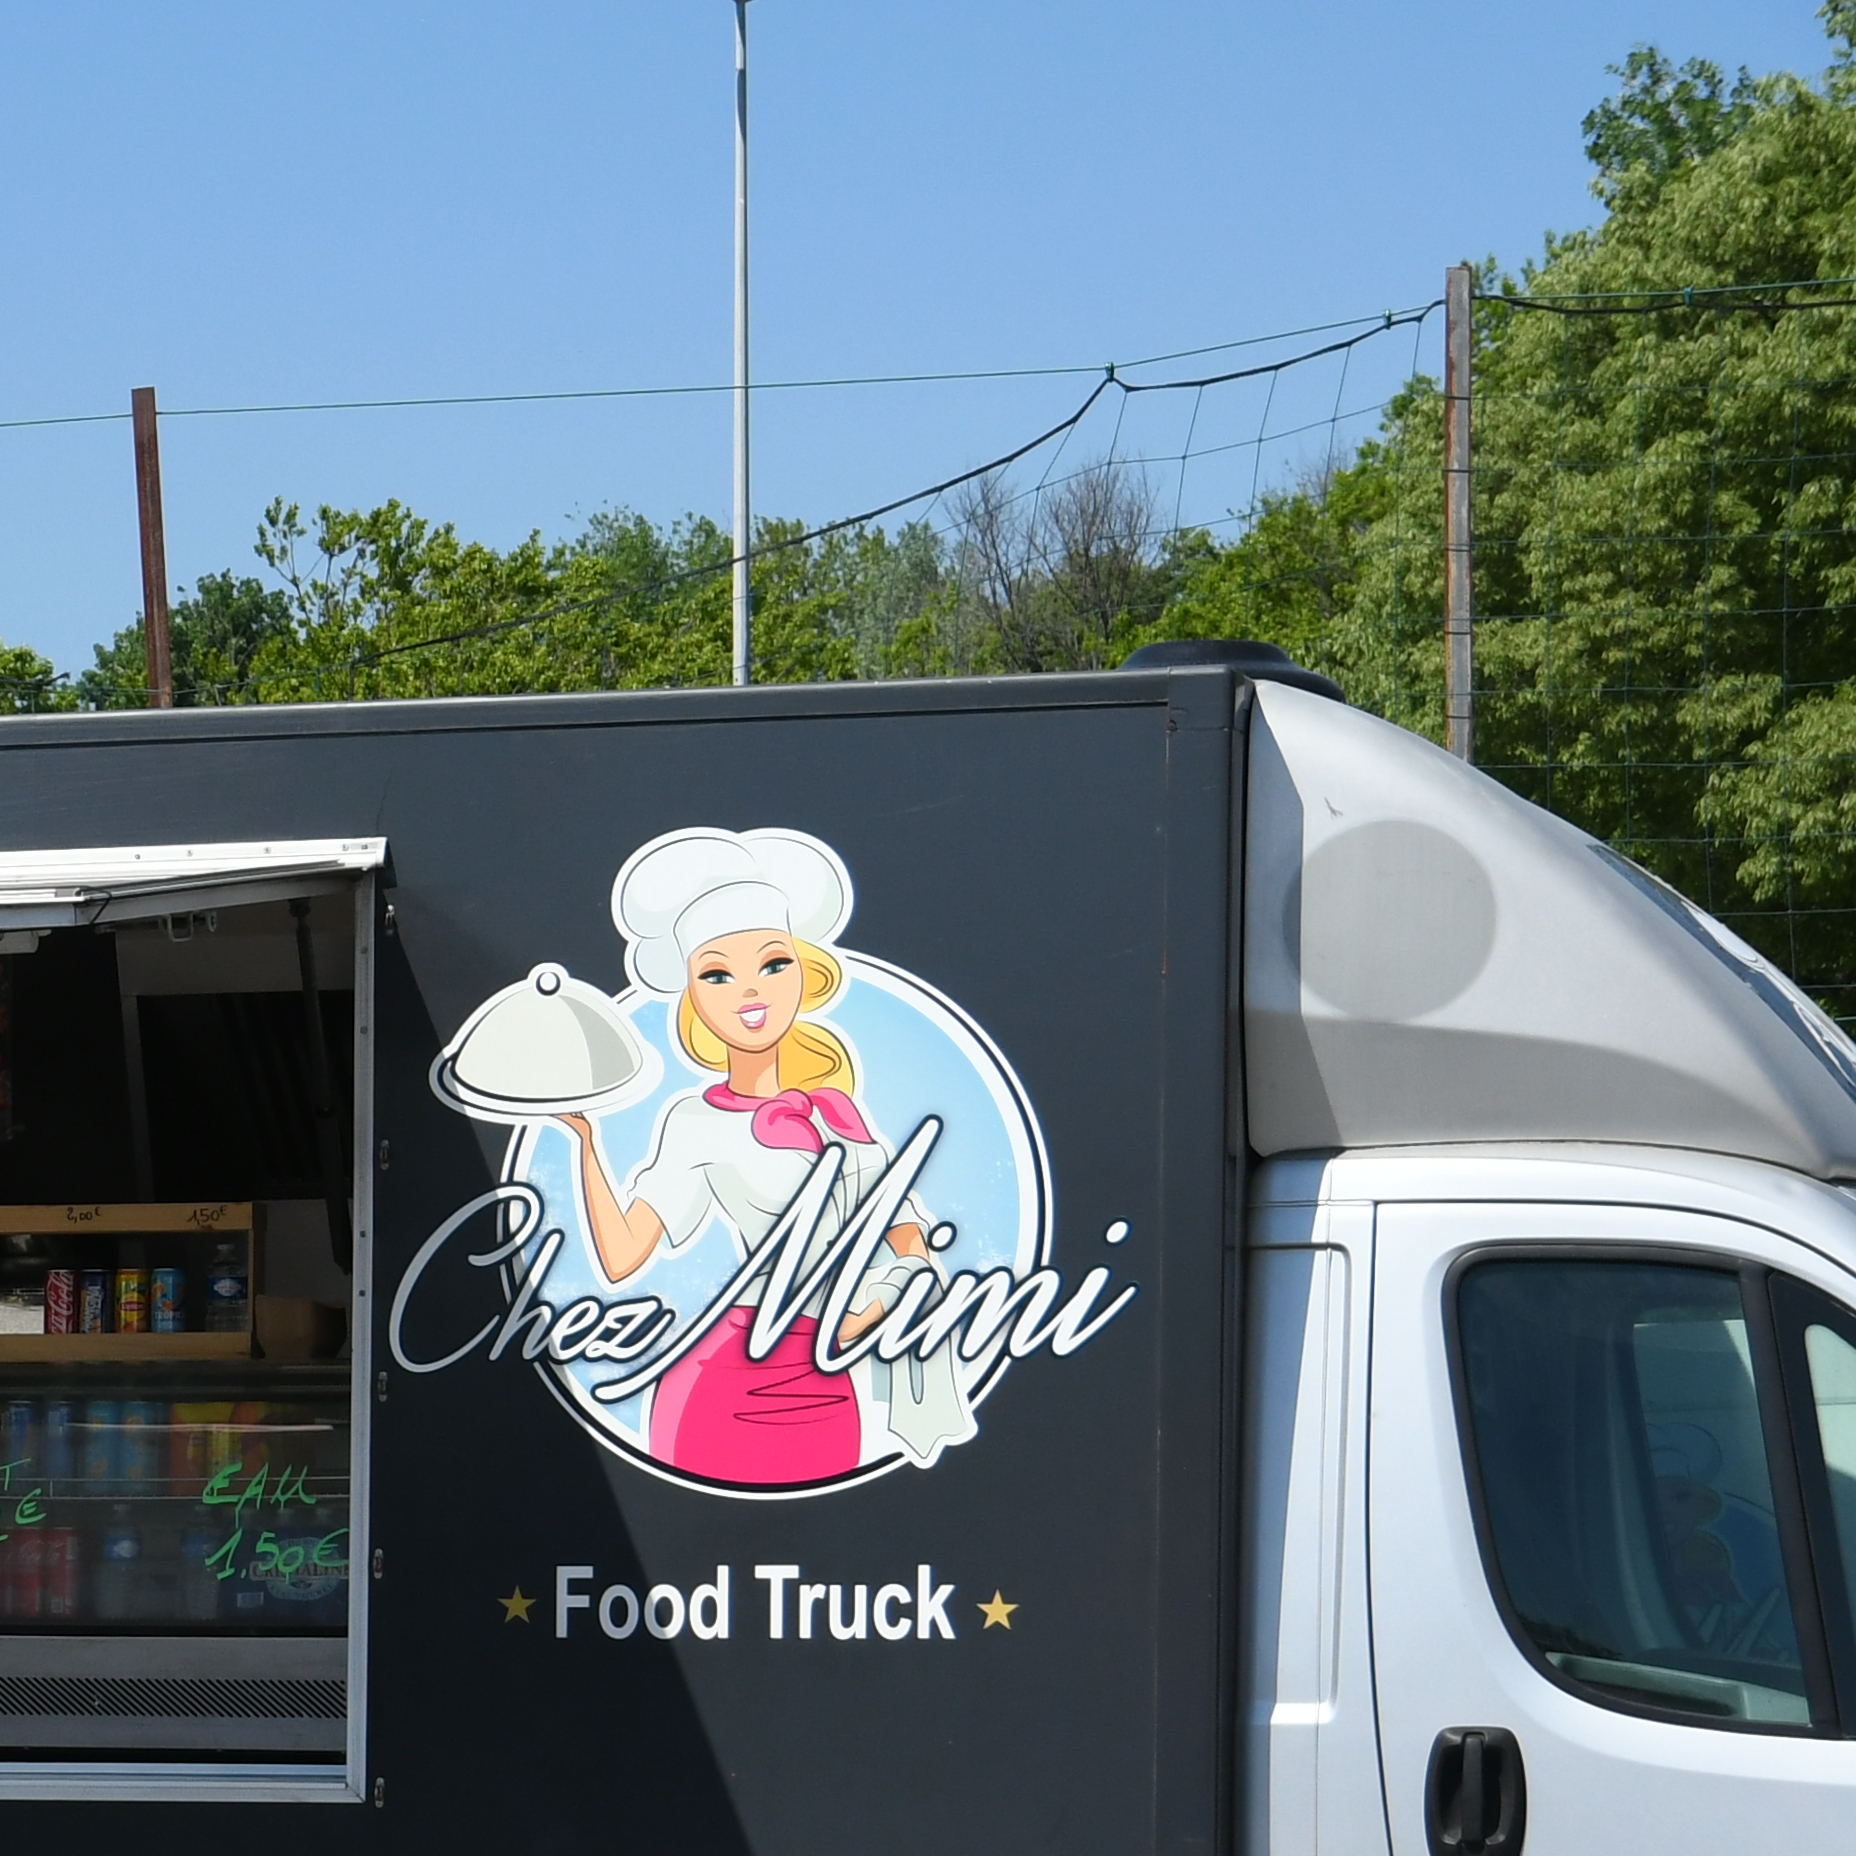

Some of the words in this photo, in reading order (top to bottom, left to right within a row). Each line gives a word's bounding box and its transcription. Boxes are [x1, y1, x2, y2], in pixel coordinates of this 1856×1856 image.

[389, 1182, 673, 1373] Chez
[594, 1113, 1139, 1403] Mimi
[202, 1461, 318, 1512] EAU
[554, 1563, 731, 1642] Food
[753, 1563, 957, 1642] Truck
